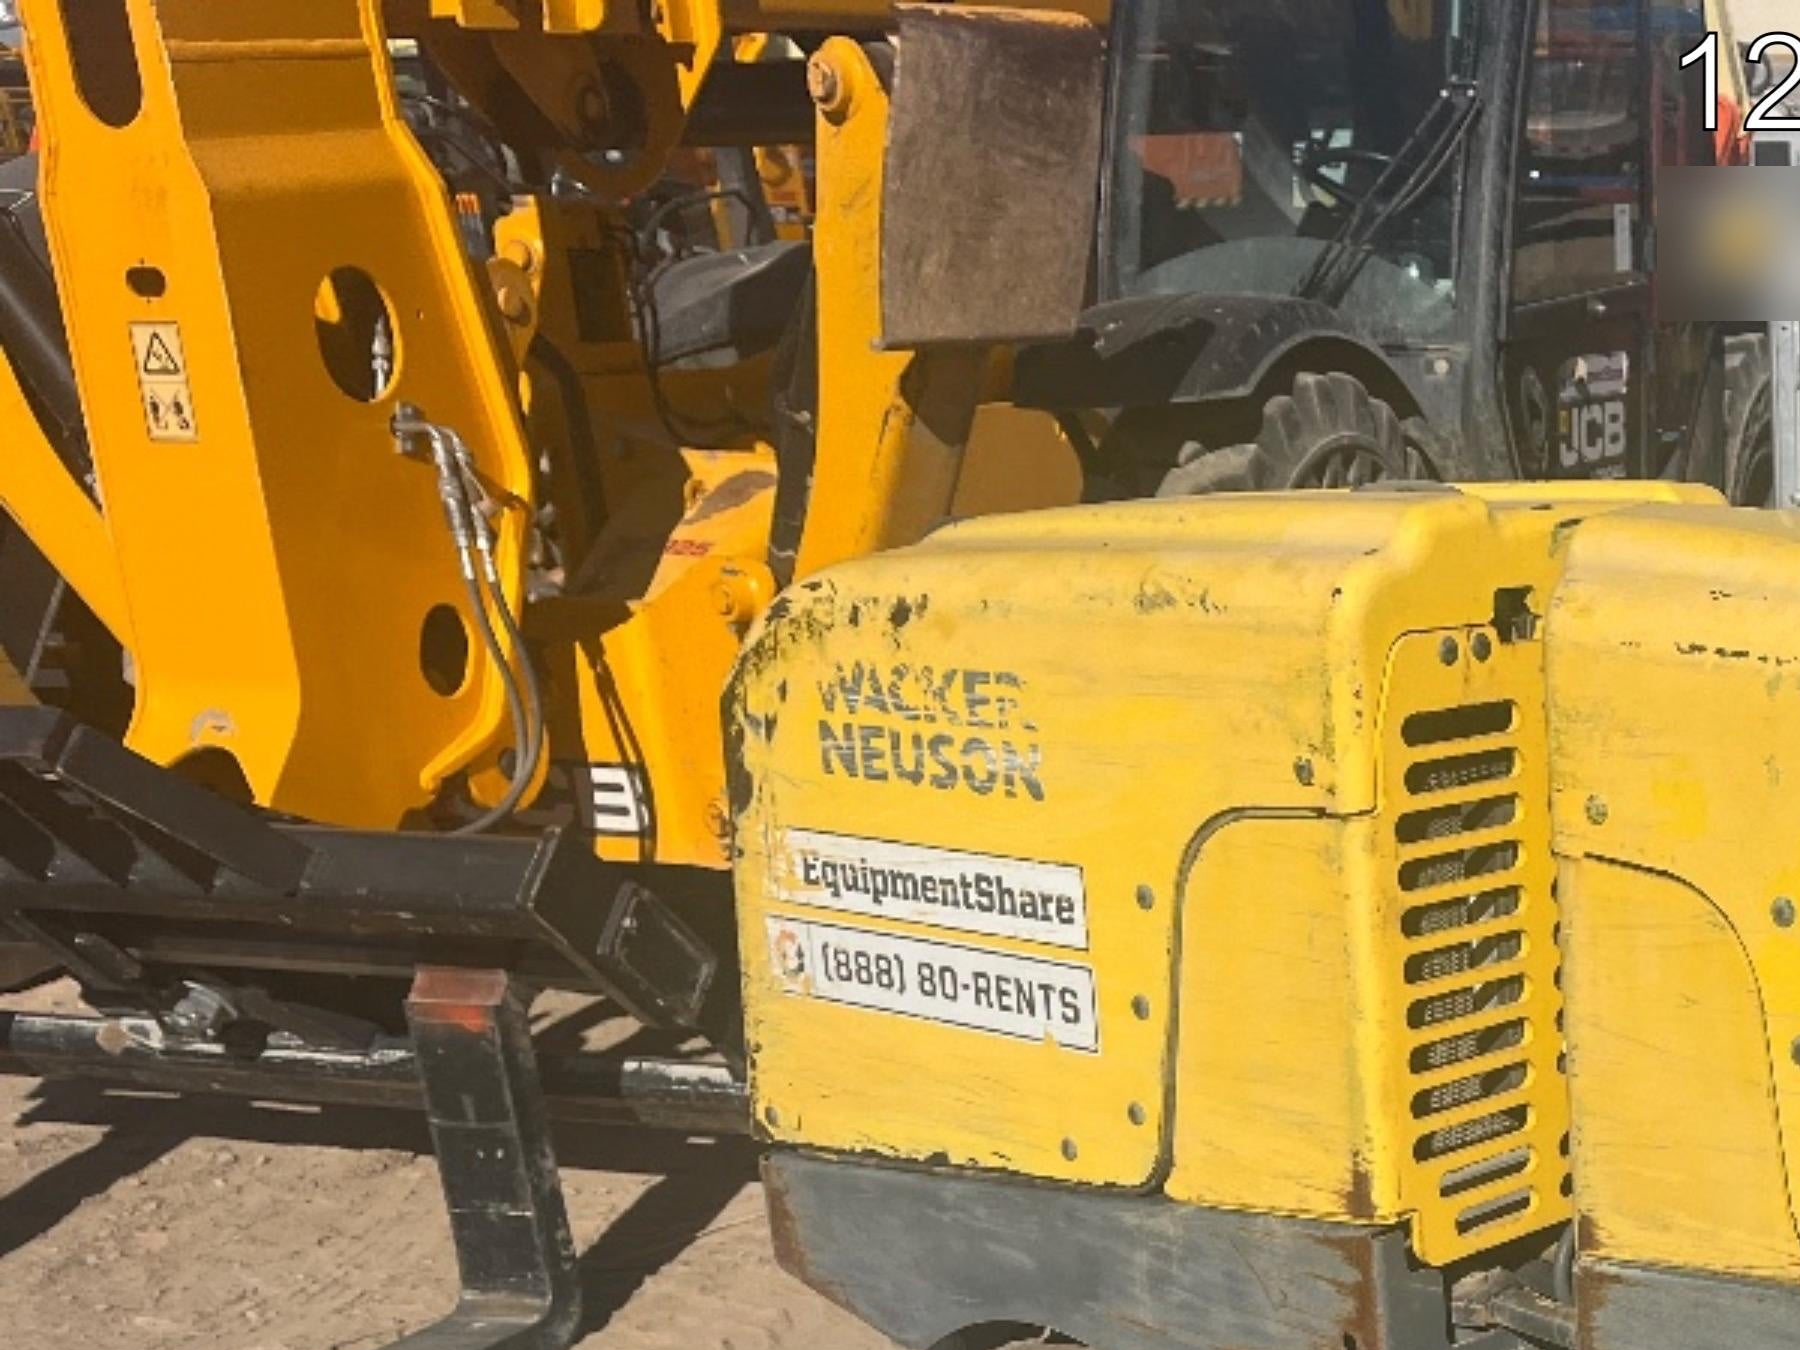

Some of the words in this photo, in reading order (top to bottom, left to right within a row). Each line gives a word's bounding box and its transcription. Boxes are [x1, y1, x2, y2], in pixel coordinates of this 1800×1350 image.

[1559, 400, 1627, 468] JCB
[818, 659, 1039, 731] WACKER
[818, 719, 1045, 801] NEUSON
[801, 855, 1076, 926] EquipmentShare
[821, 941, 907, 995] (888)
[917, 961, 1082, 1026] 80-RENTS
